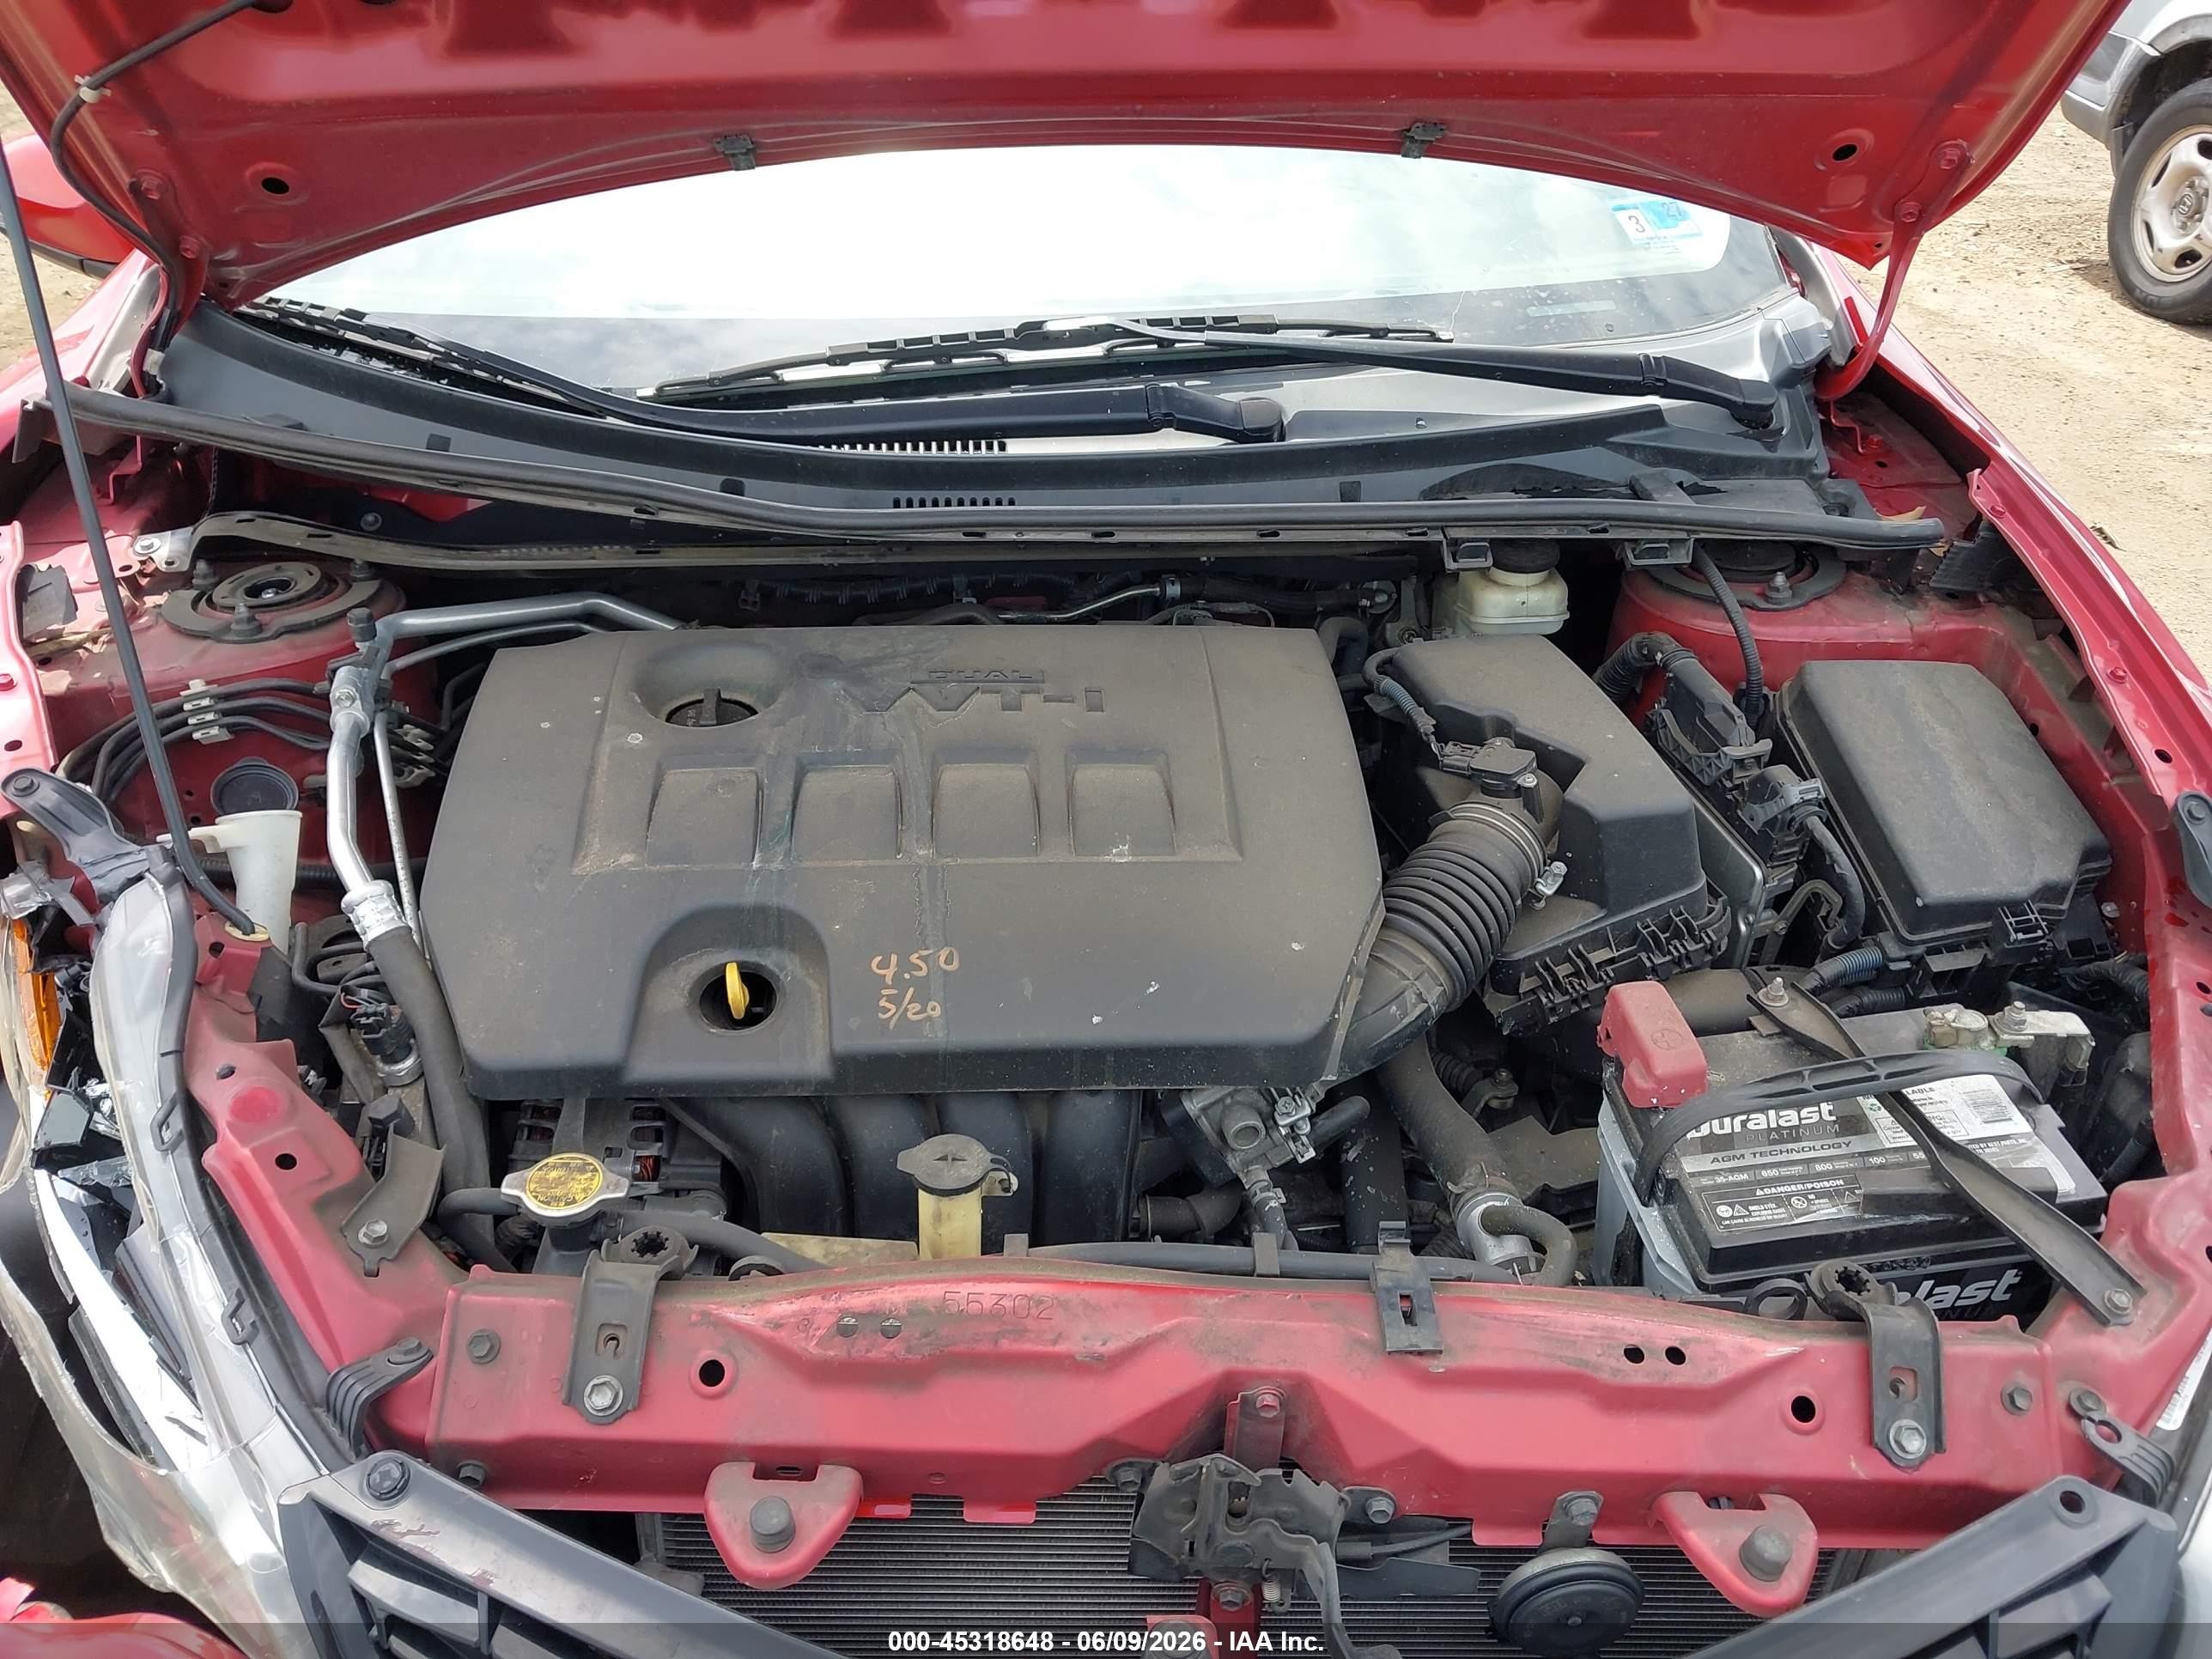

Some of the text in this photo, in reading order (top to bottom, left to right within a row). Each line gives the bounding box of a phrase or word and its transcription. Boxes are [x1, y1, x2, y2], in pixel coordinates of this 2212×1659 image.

[1627, 215, 1646, 234] 3
[870, 946, 960, 985] 4.50
[878, 986, 942, 1030] 5/20
[1746, 1123, 1840, 1143] PLATINUM
[1710, 1140, 1852, 1164] AGM TECHNOLOGY
[1869, 1156, 1887, 1164] 100
[1814, 1163, 1833, 1171] 800
[1714, 1173, 1749, 1183] 35-AGM
[1763, 1178, 1845, 1194] DANGER/POISON
[943, 1290, 1055, 1321] 55302
